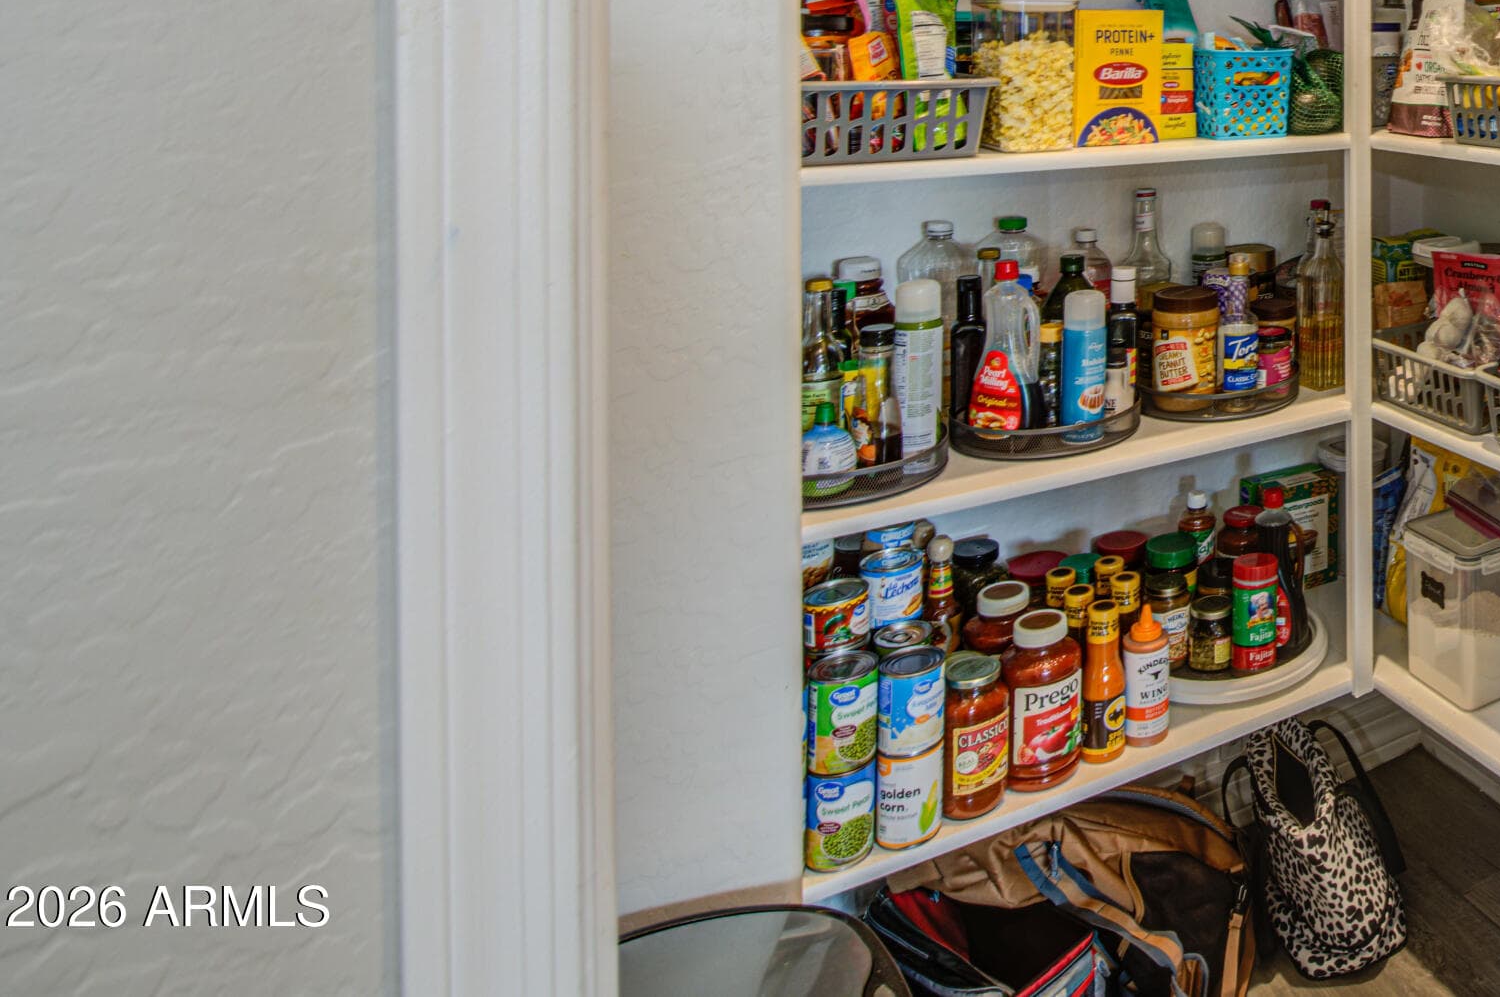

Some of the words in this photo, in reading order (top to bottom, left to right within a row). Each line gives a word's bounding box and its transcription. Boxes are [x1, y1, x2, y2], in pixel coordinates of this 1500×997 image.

[1096, 29, 1156, 44] PROTEIN+
[1110, 48, 1134, 56] PENNE
[1099, 67, 1145, 80] Barilla
[1159, 358, 1186, 370] PEANUT
[984, 366, 1007, 378] Pearl
[1159, 366, 1189, 379] BUTTER
[1024, 679, 1079, 712] Prego
[880, 788, 921, 800] golden
[880, 803, 904, 812] corn
